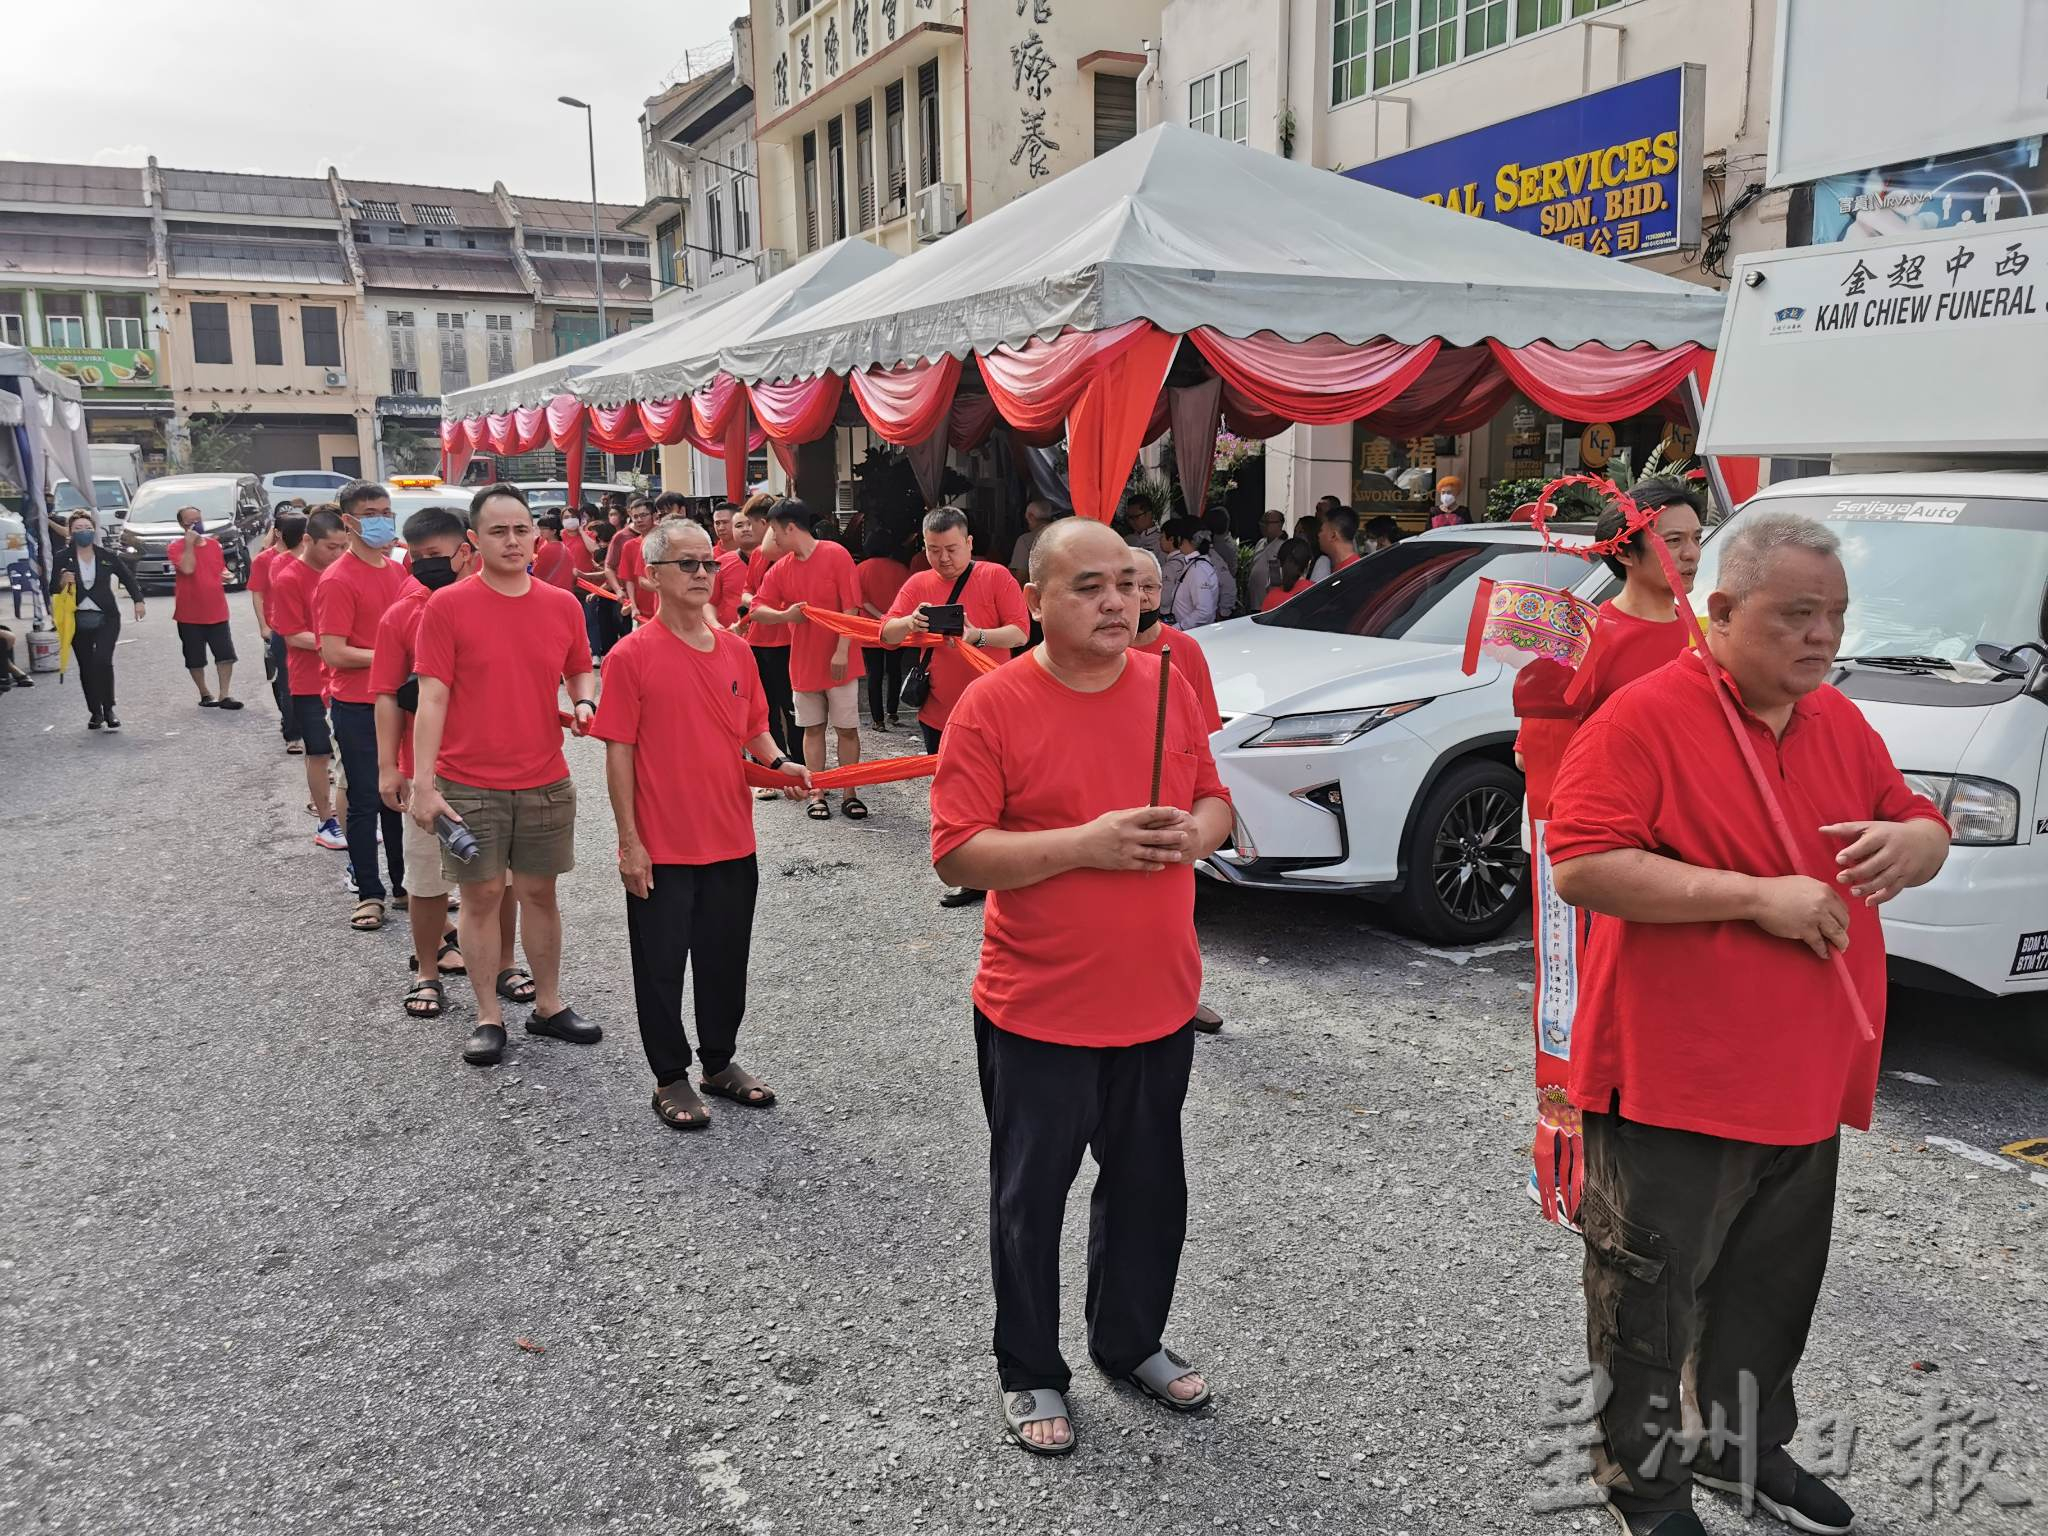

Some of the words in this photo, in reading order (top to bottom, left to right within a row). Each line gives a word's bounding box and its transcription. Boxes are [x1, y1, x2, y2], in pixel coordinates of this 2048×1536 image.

[1495, 131, 1678, 213] SERVICES
[1540, 197, 1597, 236] SDN.
[1604, 181, 1669, 222] BHD.
[1840, 243, 2029, 297] 金超中西
[1815, 301, 1859, 331] KAM
[1863, 294, 1932, 328] CHIEW
[1935, 284, 2036, 321] FUNERAL
[1910, 506, 1959, 518] Auto
[2016, 954, 2036, 971] BTM
[2021, 935, 2041, 952] BDM
